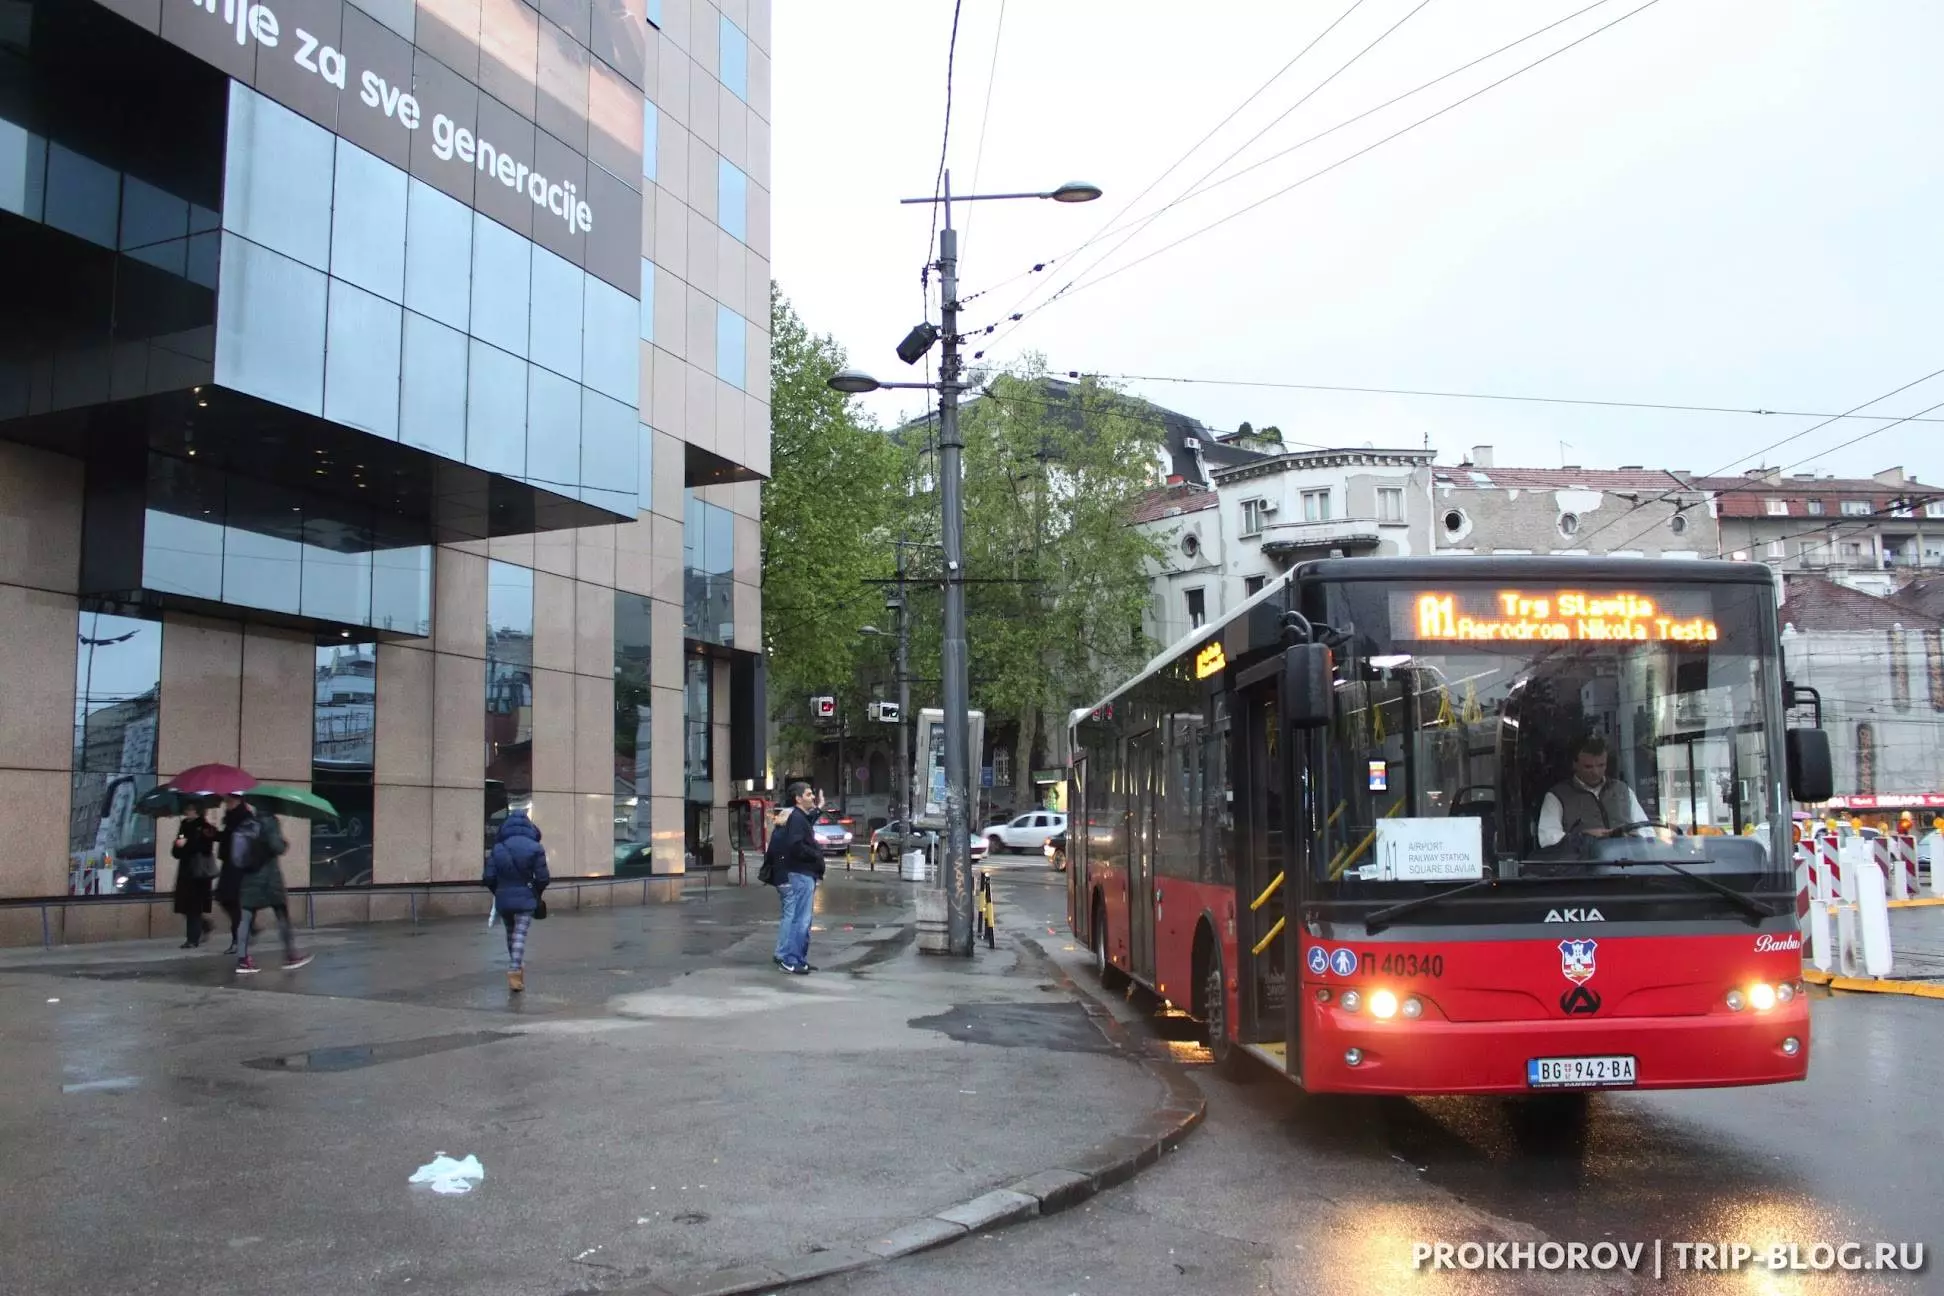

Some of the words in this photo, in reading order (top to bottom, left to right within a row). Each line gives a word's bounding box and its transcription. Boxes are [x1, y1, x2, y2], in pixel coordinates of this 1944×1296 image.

[294, 28, 346, 90] za
[360, 70, 420, 129] sve
[431, 113, 593, 234] generacije
[1418, 594, 1456, 637] A1
[1502, 593, 1549, 618] Trg
[1558, 593, 1652, 618] Slavija
[1457, 617, 1569, 640] Aerodrom
[1579, 618, 1646, 640] Nikola
[1655, 617, 1717, 640] Tesla
[1408, 842, 1443, 852] AIRPORT
[1440, 853, 1470, 861] STATION
[1408, 865, 1442, 874] SQUARE
[1444, 864, 1476, 873] SLAVIJA
[1543, 908, 1606, 923] AKIA
[1381, 953, 1444, 978] 40340
[1542, 1062, 1561, 1080] BG
